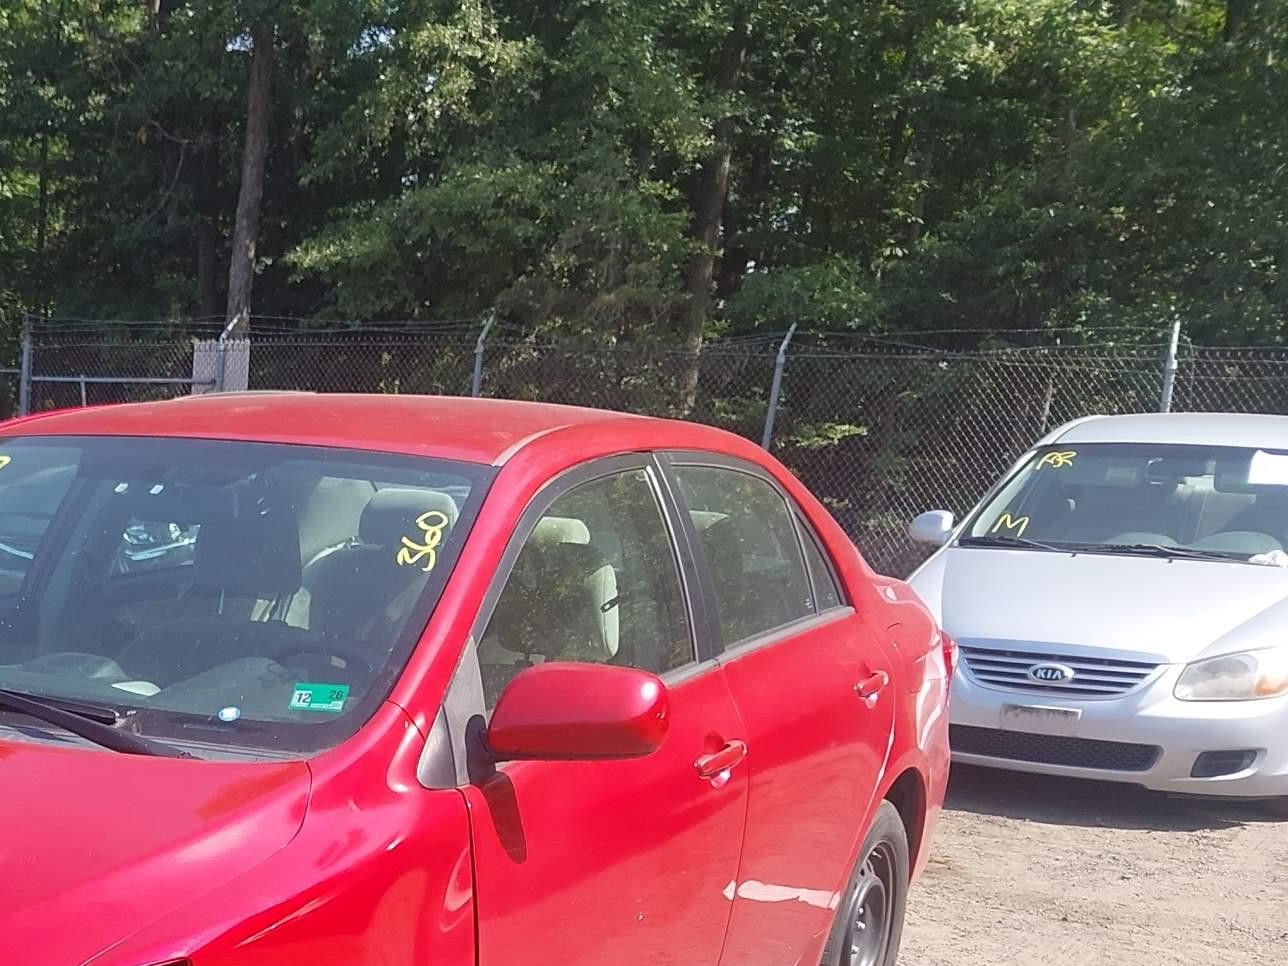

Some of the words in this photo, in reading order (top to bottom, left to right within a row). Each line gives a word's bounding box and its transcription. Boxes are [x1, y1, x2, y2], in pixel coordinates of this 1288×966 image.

[991, 513, 1030, 538] M
[396, 510, 450, 573] 360
[1036, 668, 1062, 680] KIA
[296, 692, 311, 703] 12
